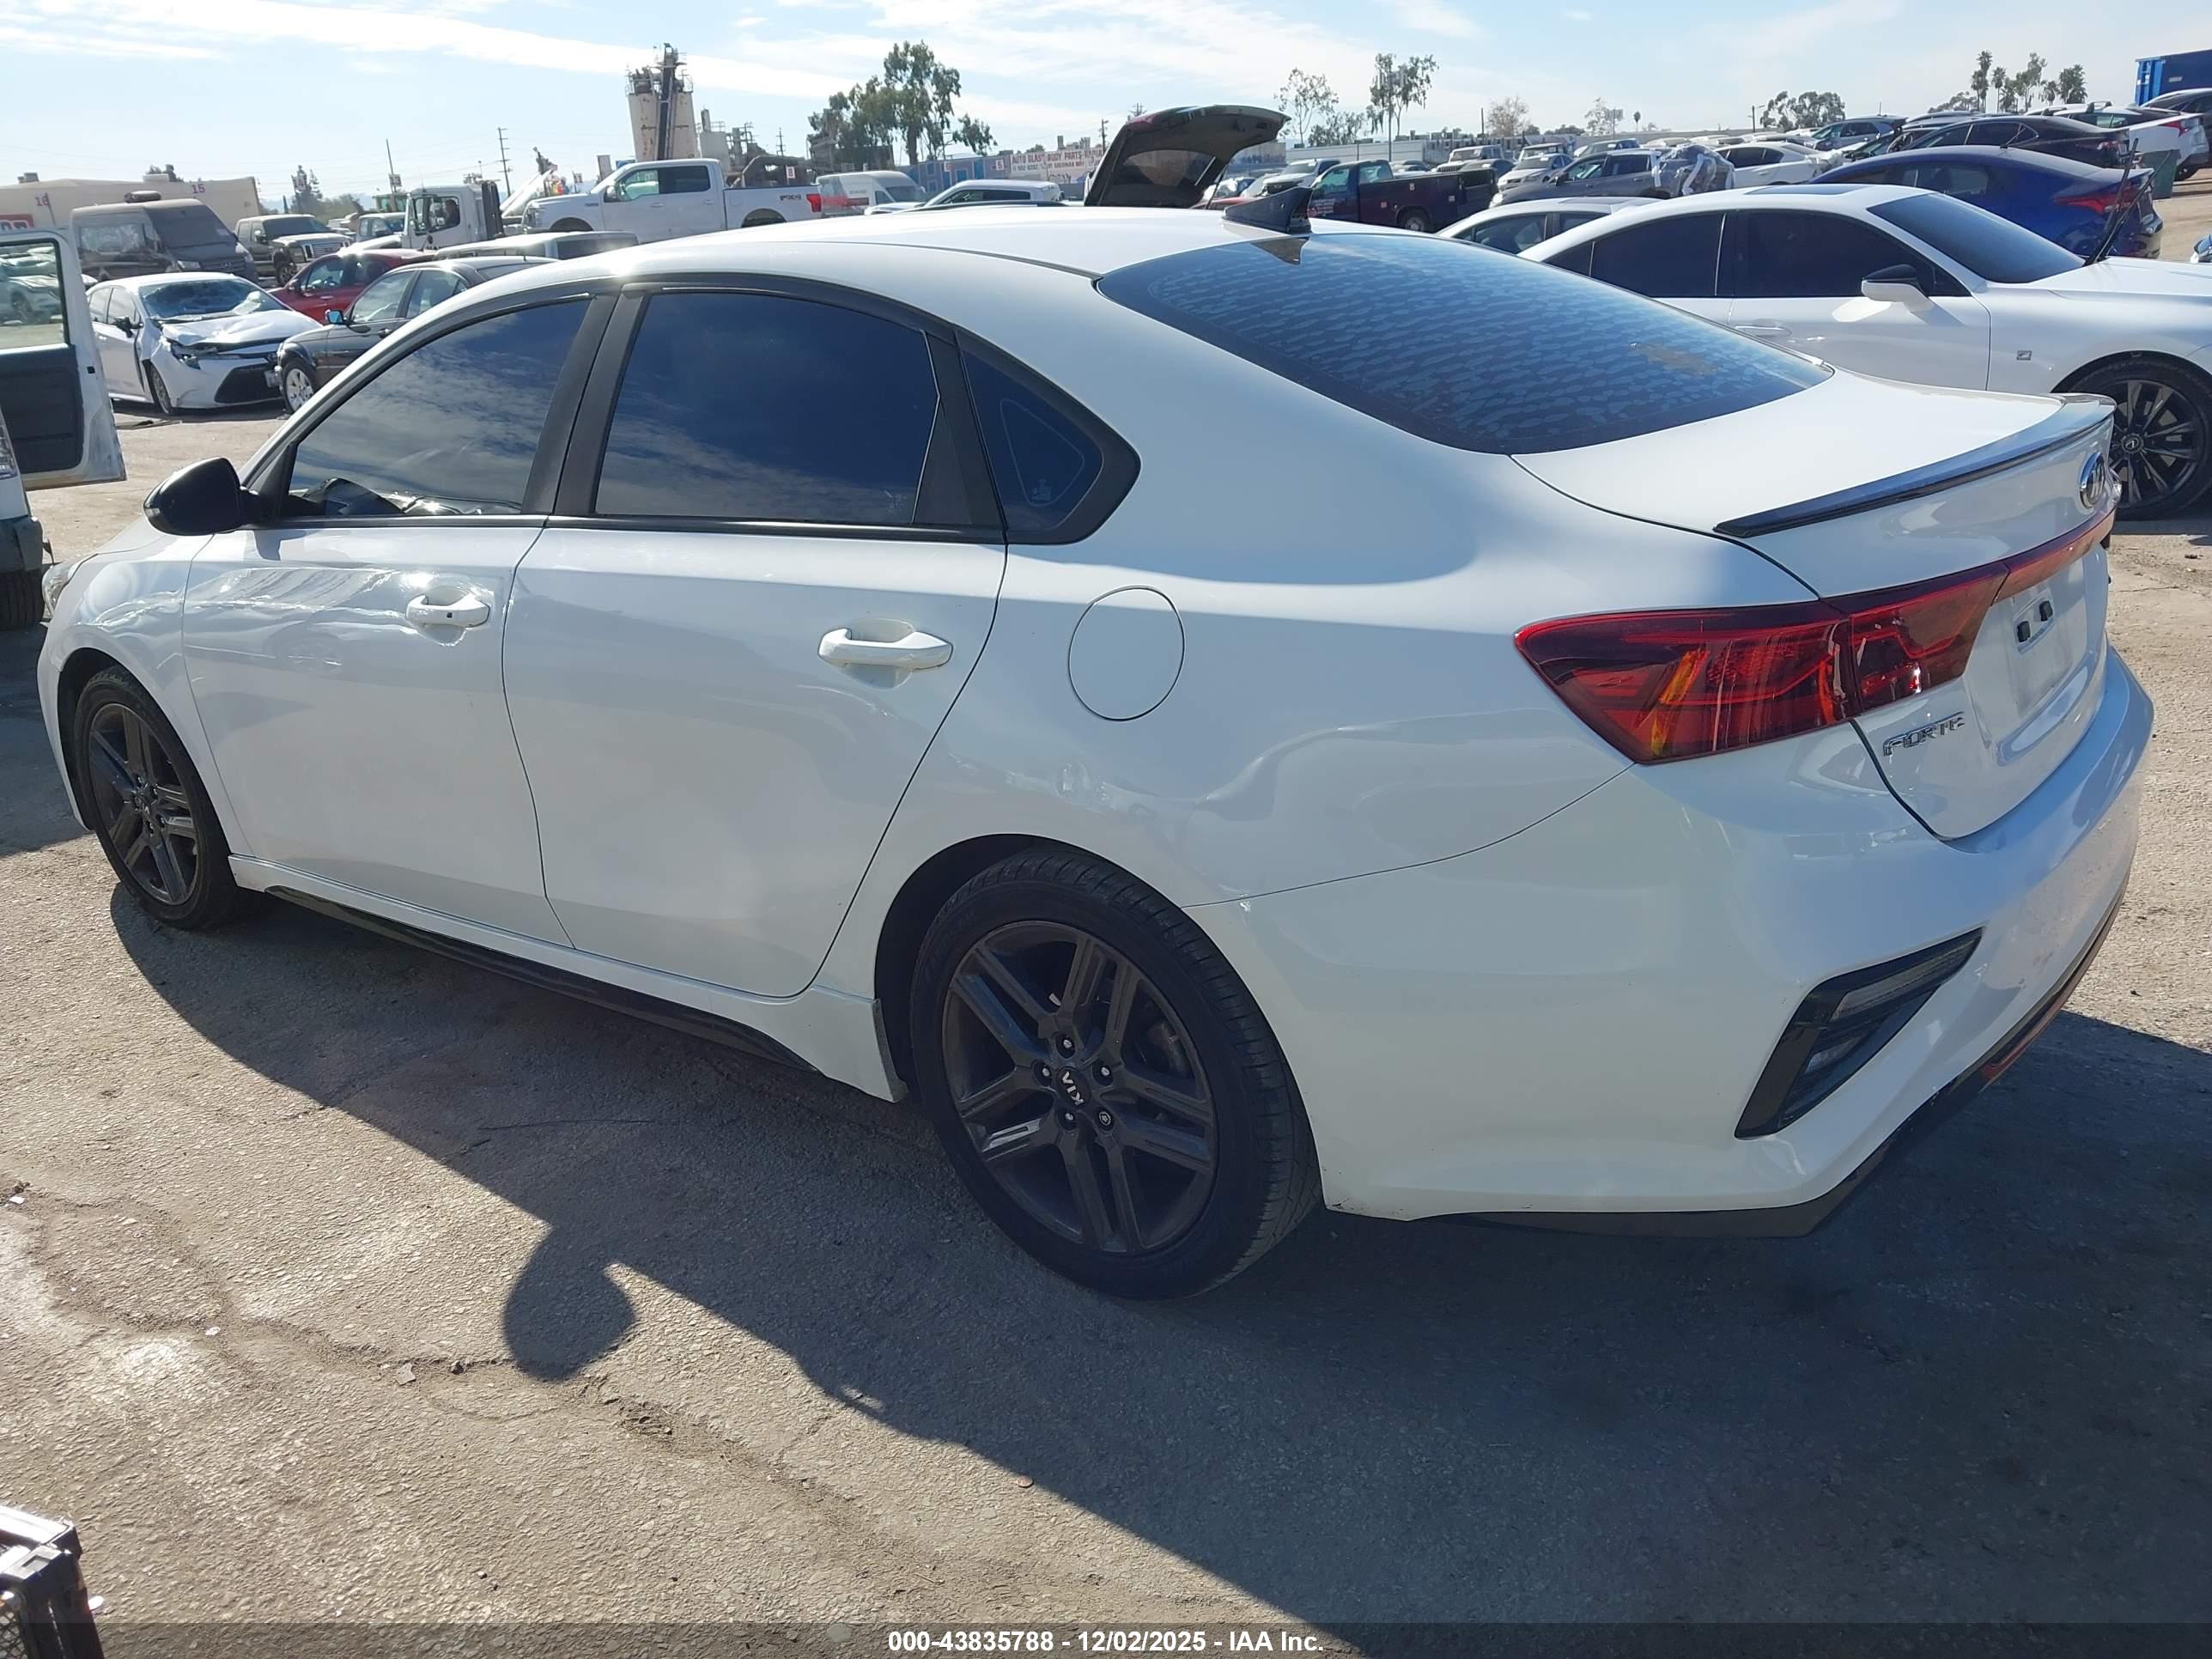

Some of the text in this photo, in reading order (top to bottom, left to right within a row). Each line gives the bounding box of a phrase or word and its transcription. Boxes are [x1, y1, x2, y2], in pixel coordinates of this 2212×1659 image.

[191, 184, 205, 194] 15
[1882, 710, 1966, 757] FORTE
[1061, 1071, 1085, 1106] KIA
